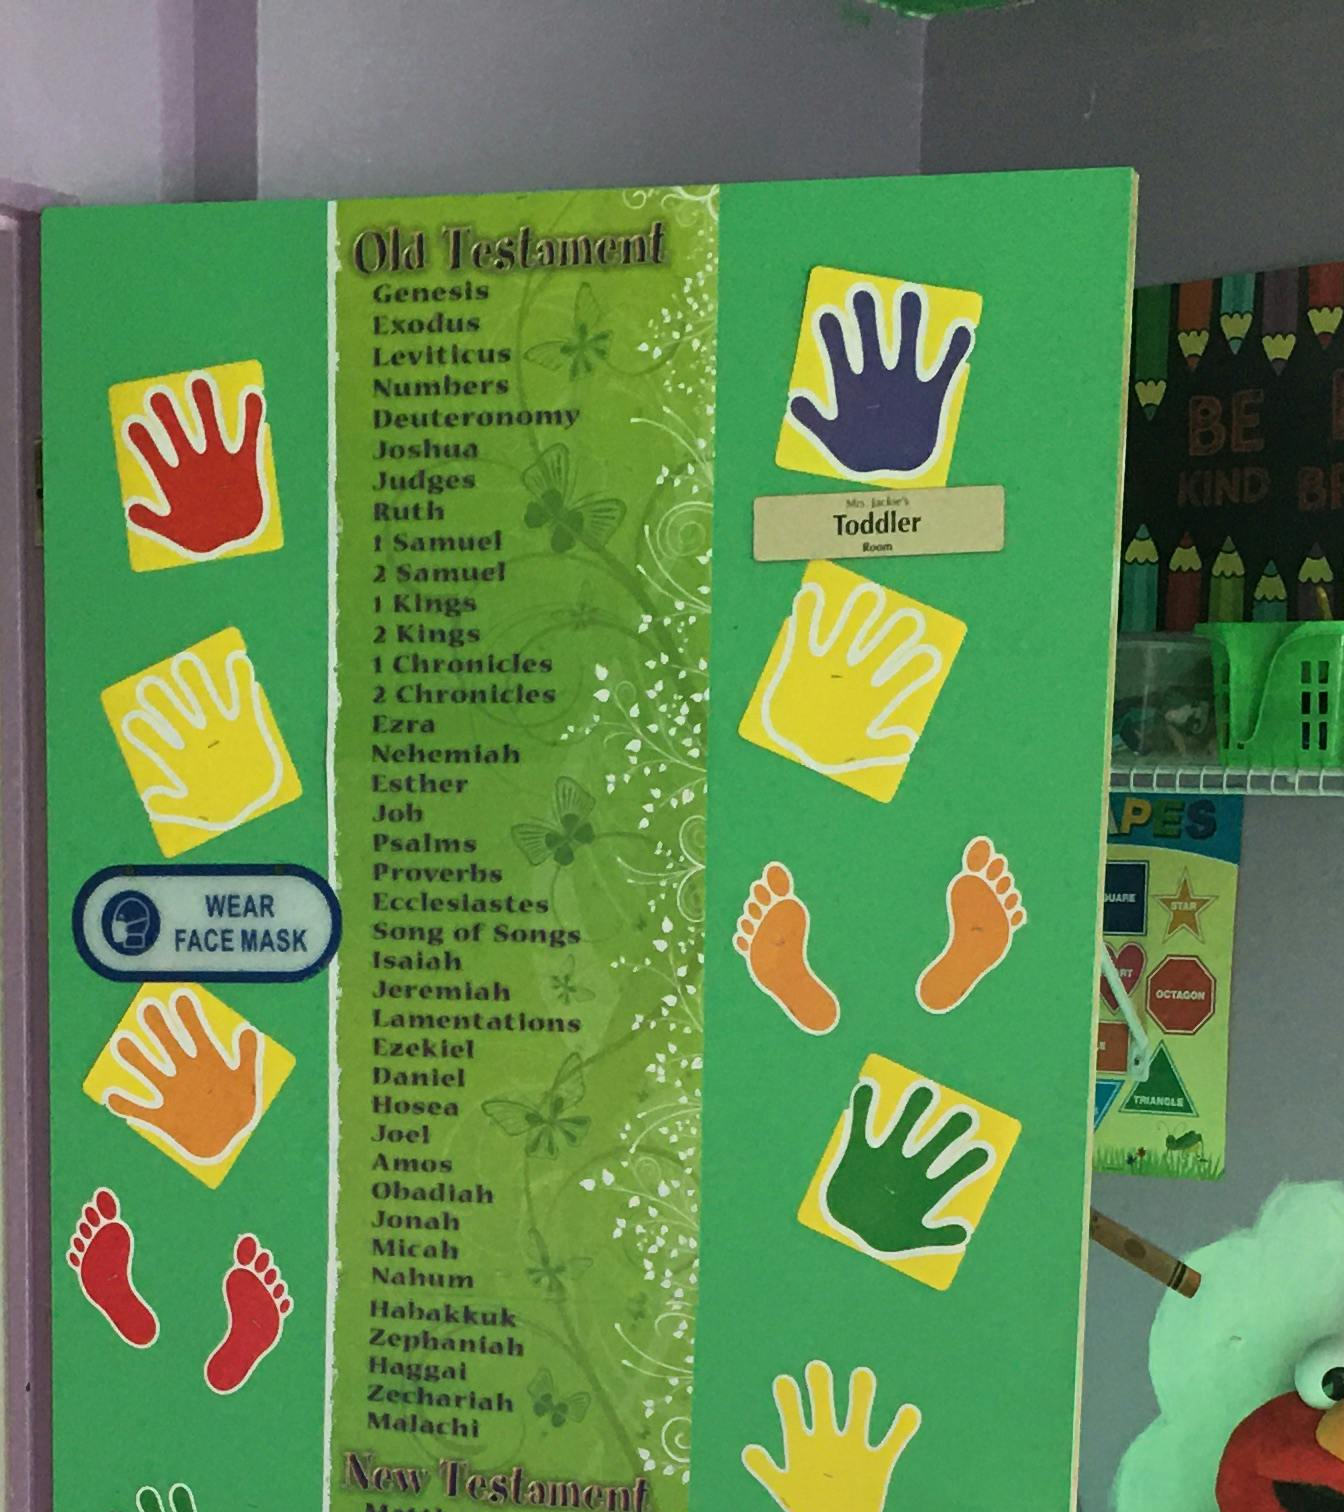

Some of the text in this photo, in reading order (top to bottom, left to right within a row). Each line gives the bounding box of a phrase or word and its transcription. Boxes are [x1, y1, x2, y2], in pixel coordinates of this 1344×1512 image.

[354, 221, 666, 275] Old Testament
[373, 281, 489, 303] Genesis
[373, 312, 480, 335] Exodus
[373, 343, 511, 368] Leviticus
[373, 375, 509, 397] Numbers
[373, 406, 580, 430] Deuteronomy
[1188, 389, 1265, 457] BE
[372, 439, 479, 459] Joshua
[372, 470, 476, 494] Judges
[1177, 468, 1270, 507] KIND
[373, 501, 445, 521] Ruth
[833, 511, 922, 536] Toddler
[373, 530, 502, 551] 1 Samuel
[863, 542, 893, 552] Room
[374, 594, 477, 617] 1 Kings
[373, 654, 552, 674] 1 Chronicles
[373, 715, 435, 734] Ezra
[372, 744, 520, 764] Nehemiah
[372, 774, 468, 793] Esther
[372, 804, 423, 822] Job
[372, 833, 477, 853] Psalms
[372, 862, 502, 882] Proverbs
[206, 894, 274, 918] WEAR
[373, 892, 549, 913] Ecclesiastes
[1171, 901, 1198, 912] STAR
[174, 928, 307, 952] FACE MASK
[373, 921, 581, 948] Song of Songs
[372, 951, 462, 971] Isaiah
[372, 980, 510, 1001] Jeremiah
[1156, 989, 1205, 1000] OCTAGON
[372, 1009, 581, 1032] Lamentations
[373, 1038, 474, 1058] Ezekiel
[373, 1067, 465, 1087] Daniel
[372, 1095, 459, 1116] Hosea
[1134, 1095, 1184, 1107] TRIANGLE
[371, 1124, 430, 1144] Joel
[372, 1152, 453, 1174] Amos
[372, 1181, 494, 1203] Obadiah
[371, 1210, 460, 1231] Jonah
[372, 1238, 460, 1260] Micah
[372, 1267, 474, 1288] Nahum
[370, 1299, 517, 1328] Habakkuk
[369, 1328, 524, 1357] Zephaniah
[368, 1356, 467, 1382] Haggai
[367, 1384, 514, 1412] Zechariah
[367, 1411, 480, 1438] Malachi
[344, 1450, 428, 1494] New
